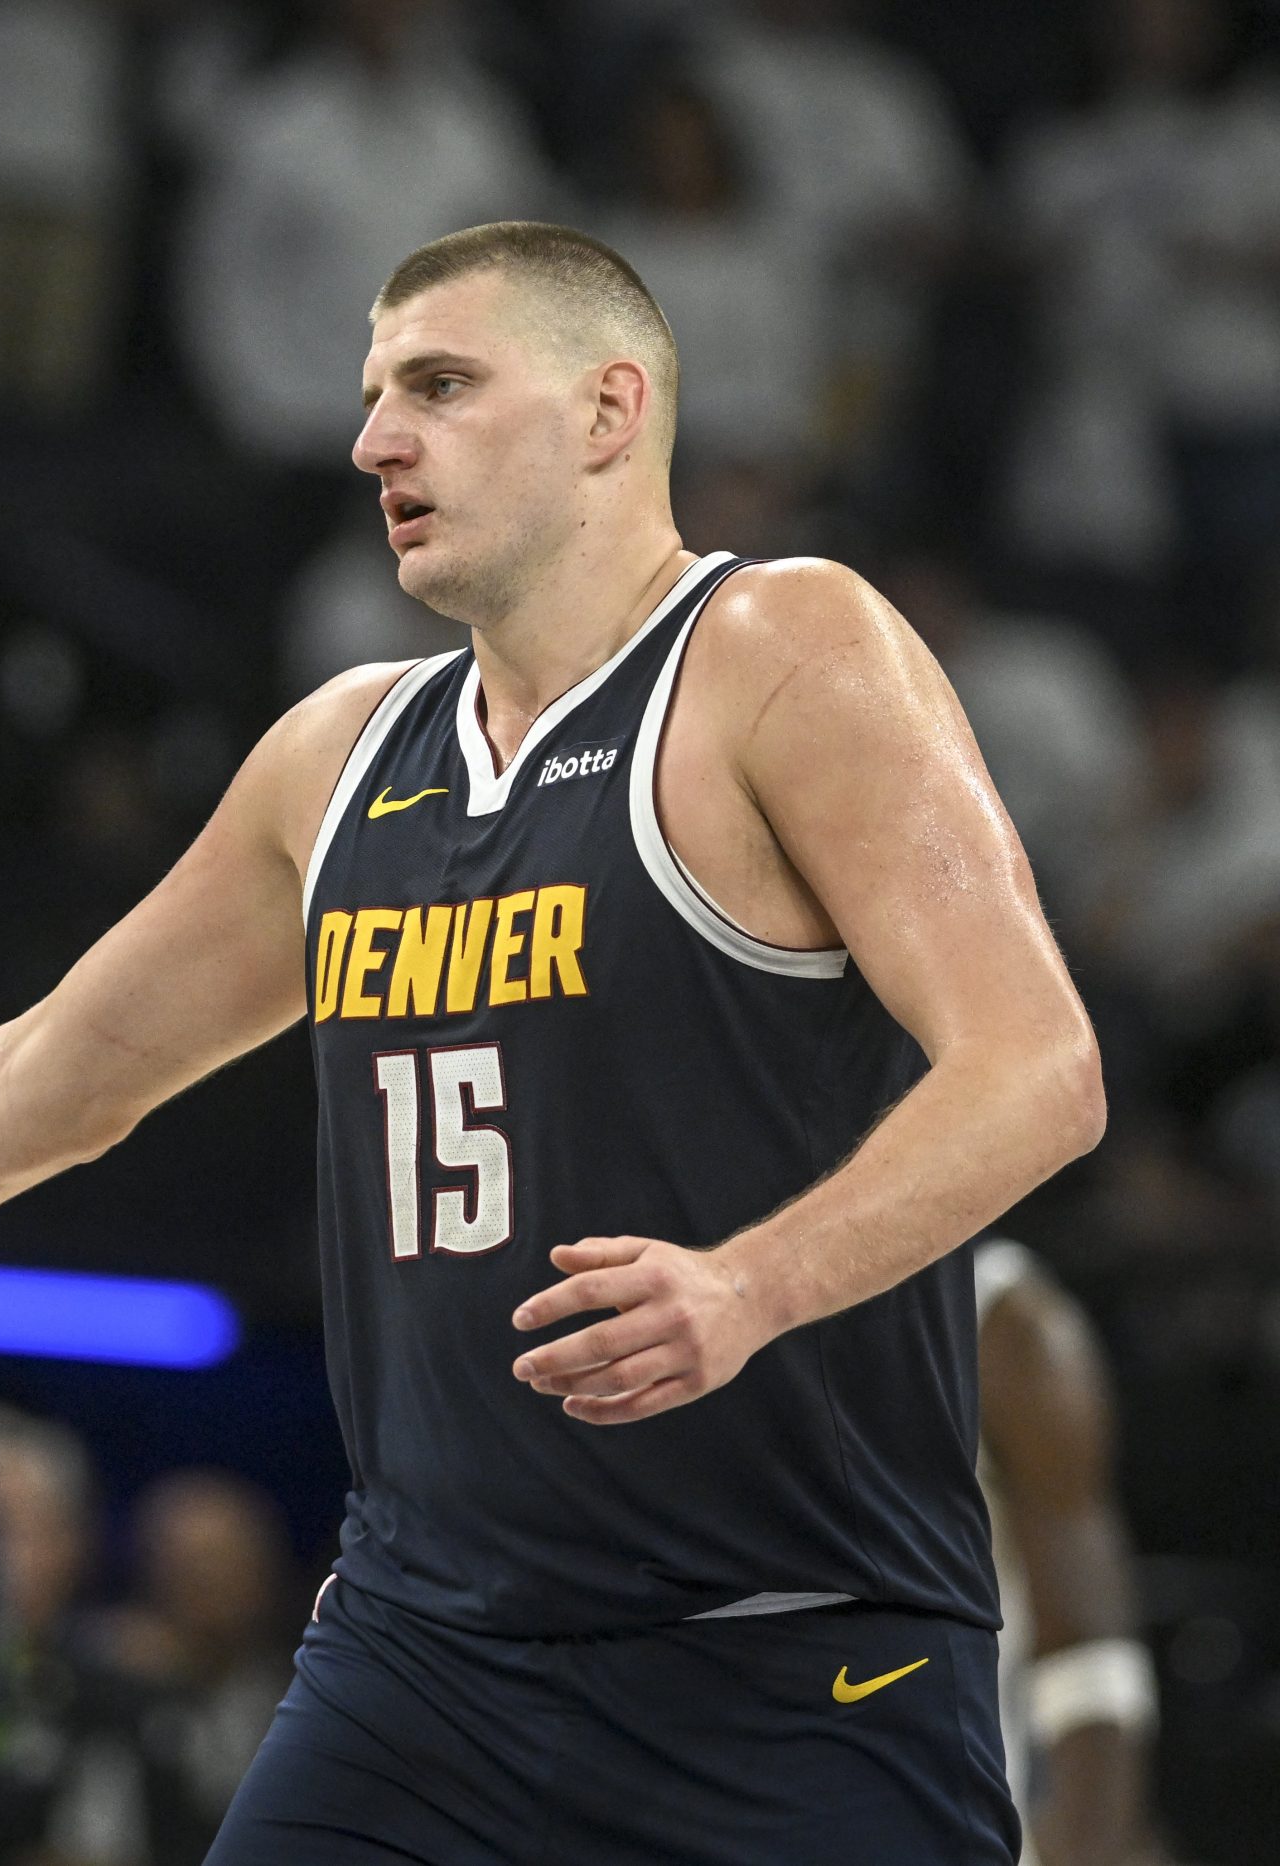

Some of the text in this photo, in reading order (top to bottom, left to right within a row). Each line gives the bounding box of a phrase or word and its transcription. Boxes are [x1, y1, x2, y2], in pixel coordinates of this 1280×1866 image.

[537, 748, 618, 787] ibotta
[314, 884, 589, 1025] DENVER
[372, 1041, 515, 1262] 15
